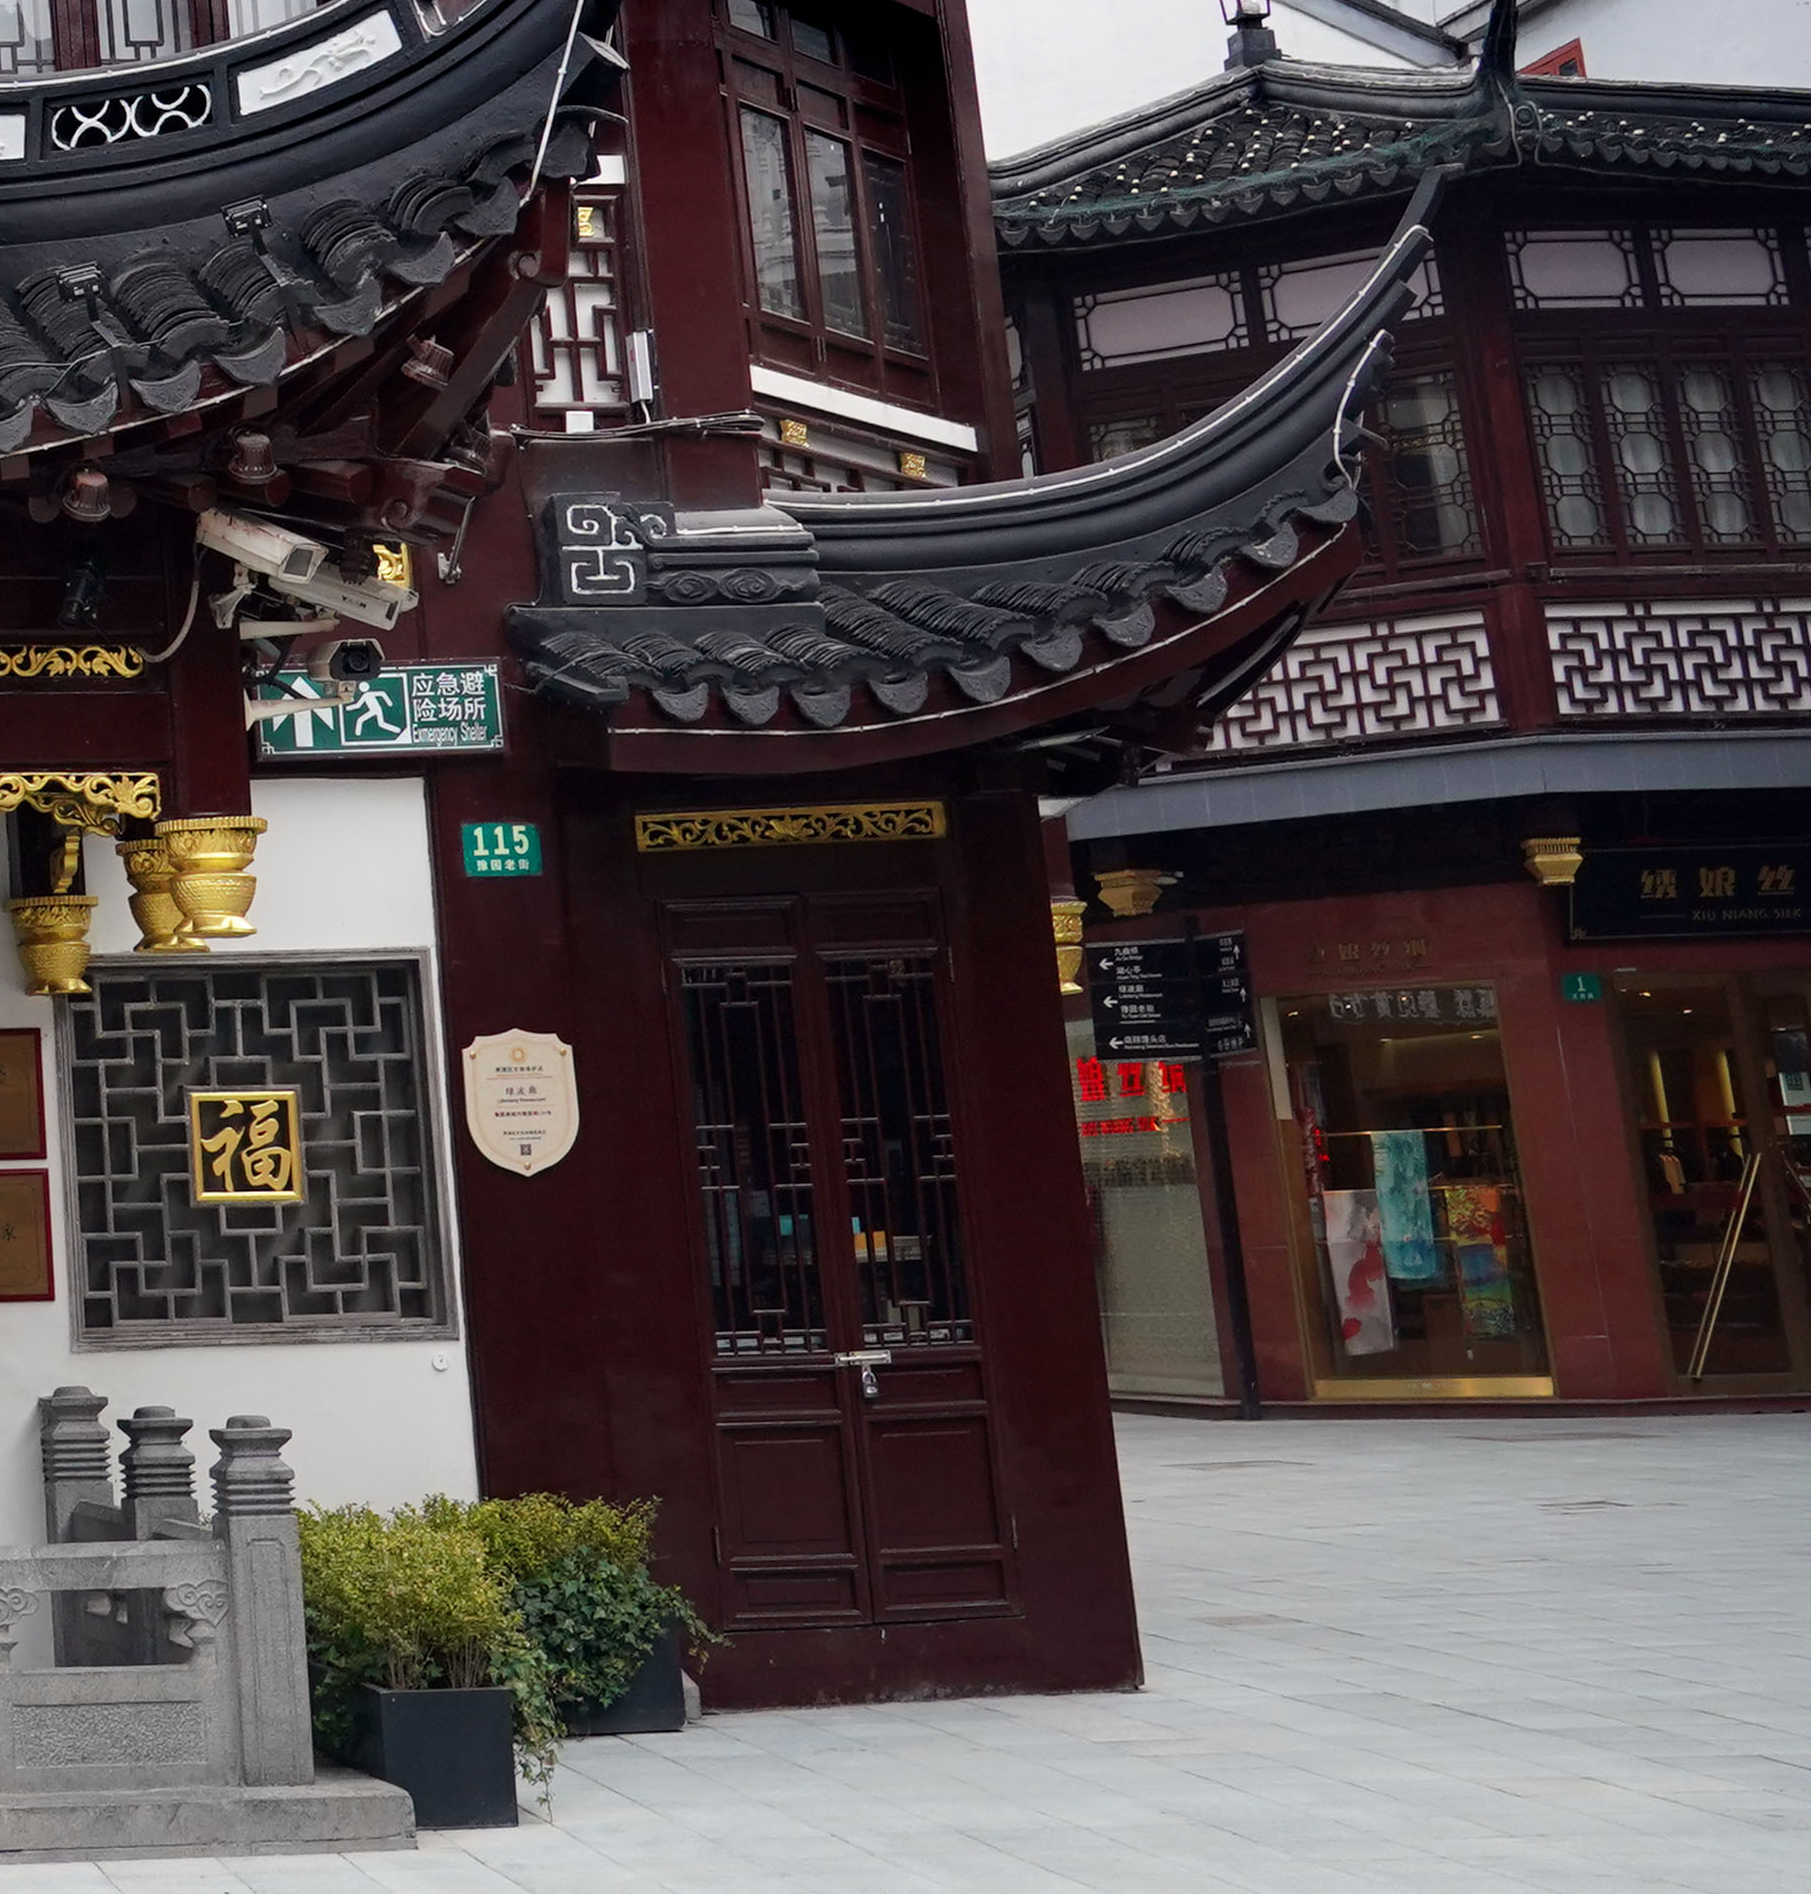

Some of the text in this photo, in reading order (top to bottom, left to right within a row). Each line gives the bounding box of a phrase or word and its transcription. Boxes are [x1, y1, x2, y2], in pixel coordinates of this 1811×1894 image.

[412, 671, 485, 697] 应急避
[413, 697, 486, 722] 险场所
[473, 825, 529, 856] 115
[476, 858, 530, 872] 豫园老街
[1640, 865, 1795, 899] 绣娘丝
[1692, 907, 1801, 921] XIU NIANG SILK
[1577, 977, 1586, 992] 1
[200, 1100, 294, 1191] 福
